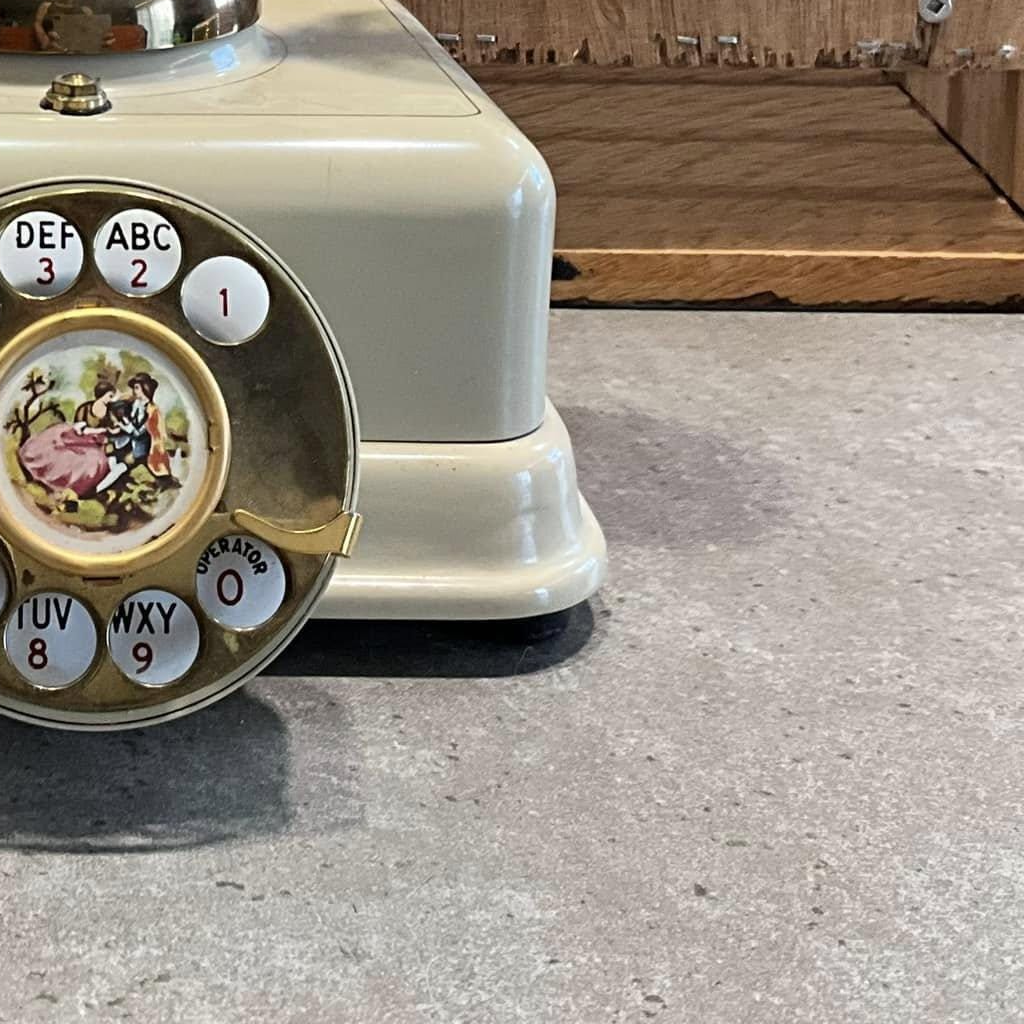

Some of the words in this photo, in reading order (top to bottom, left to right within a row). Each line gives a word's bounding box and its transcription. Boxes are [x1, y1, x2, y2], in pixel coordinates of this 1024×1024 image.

[16, 221, 74, 249] DEF
[105, 222, 171, 251] ABC
[36, 257, 55, 285] 3
[130, 259, 148, 287] 2
[219, 288, 228, 316] 1
[197, 538, 267, 575] OPERATOR
[217, 569, 243, 606] 0
[112, 602, 177, 634] WXY
[28, 638, 48, 669] 8
[132, 642, 153, 674] 9
